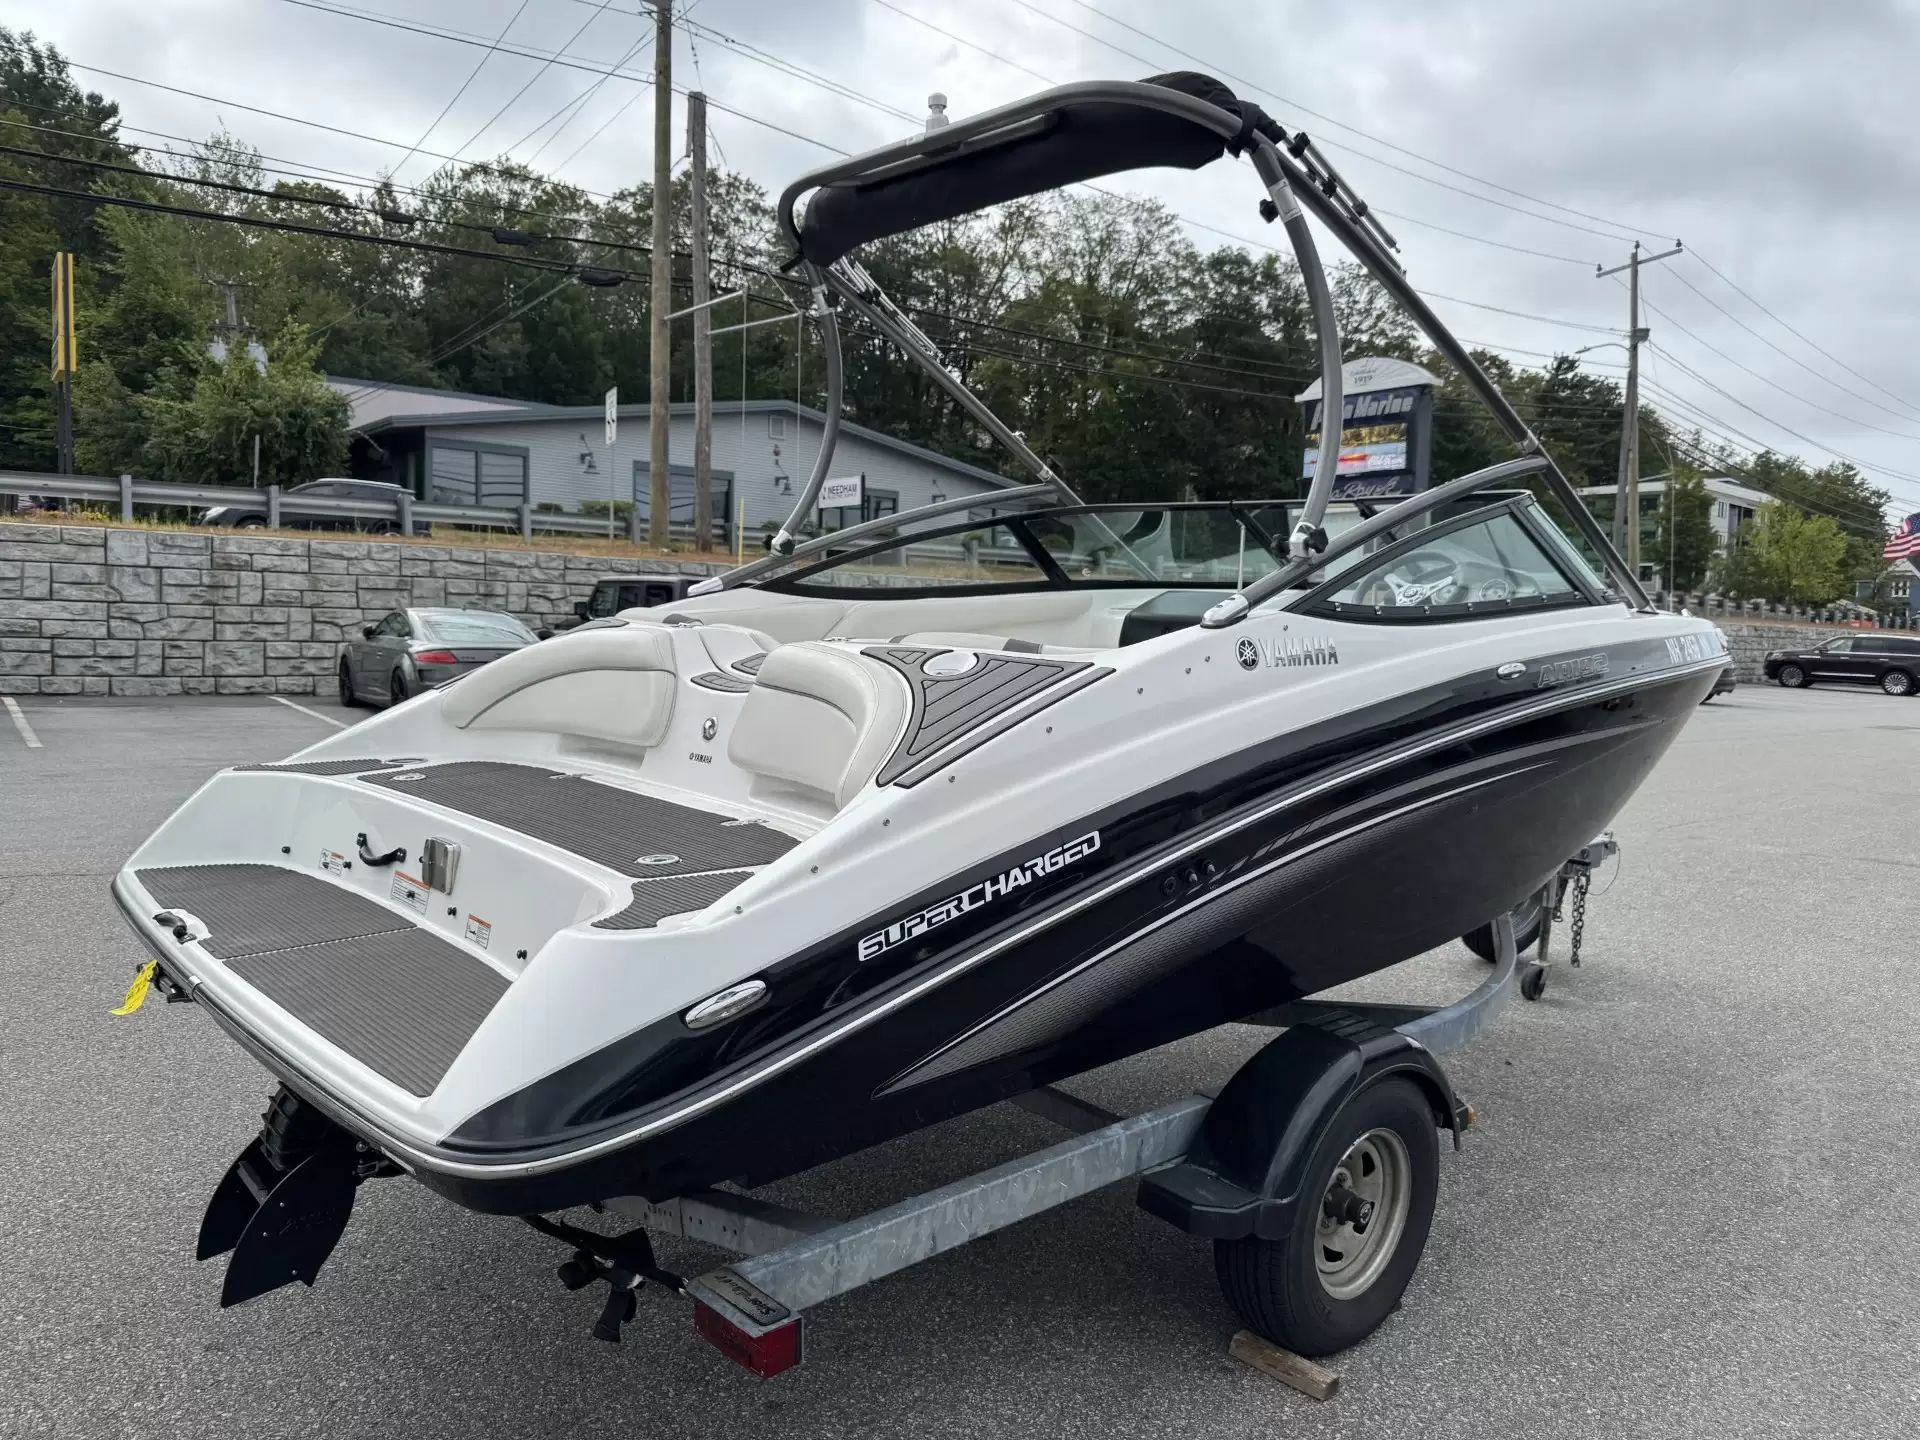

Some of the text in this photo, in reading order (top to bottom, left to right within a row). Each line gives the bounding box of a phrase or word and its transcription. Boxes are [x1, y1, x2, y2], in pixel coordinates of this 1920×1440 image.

[1353, 394, 1414, 418] Marine
[828, 484, 857, 495] NEEDHAM
[1258, 636, 1338, 668] YAMAHA
[694, 753, 712, 763] YAMAHA
[858, 830, 1101, 962] SUPERCHARGED
